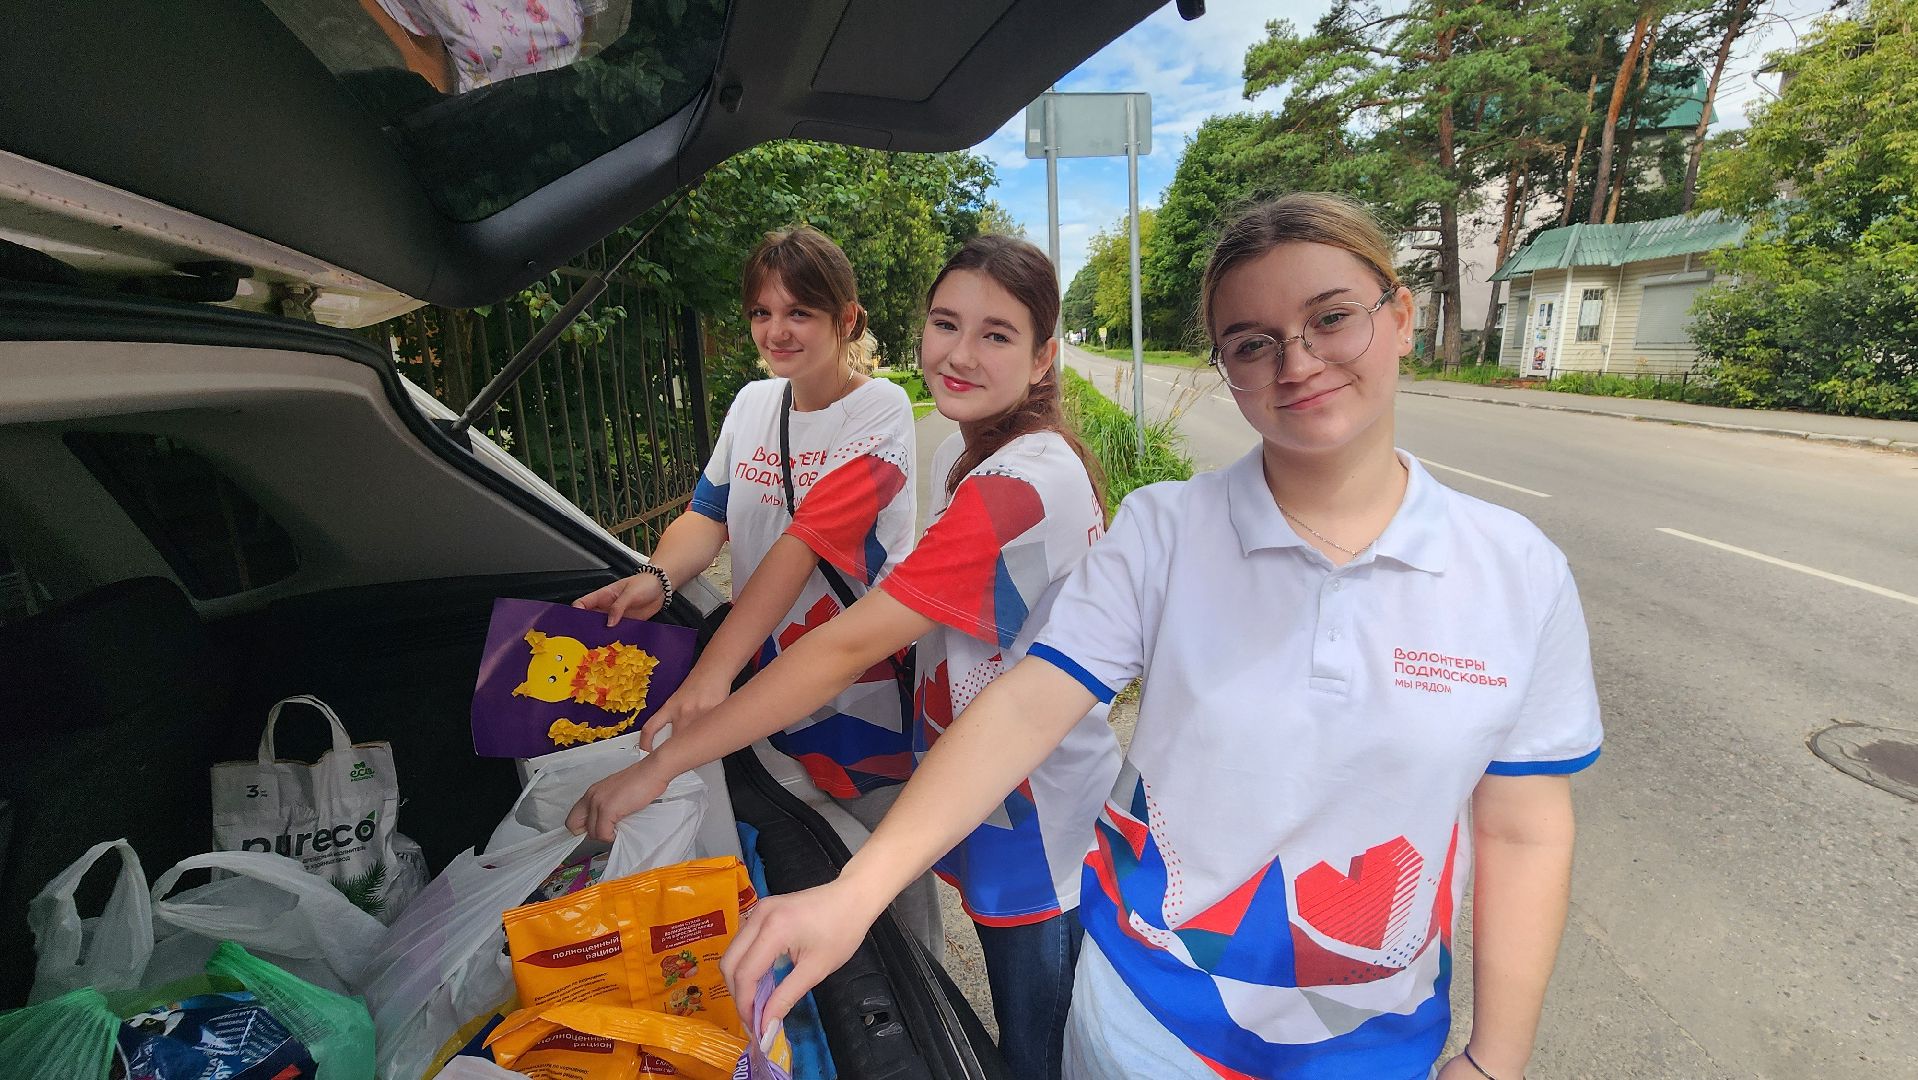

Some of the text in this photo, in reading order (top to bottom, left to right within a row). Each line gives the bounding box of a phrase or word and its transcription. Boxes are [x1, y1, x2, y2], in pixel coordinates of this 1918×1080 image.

[761, 494, 783, 507] МЫ
[1394, 647, 1486, 671] ВОЛОНТЕРЫ
[1394, 661, 1508, 687] ПОДМОСКОВЬЯ
[1394, 678, 1452, 694] МЫ РЯДОМ
[246, 784, 260, 798] 3
[552, 936, 619, 960] полноценный
[585, 945, 620, 960] рацион
[573, 1041, 612, 1049] рацион
